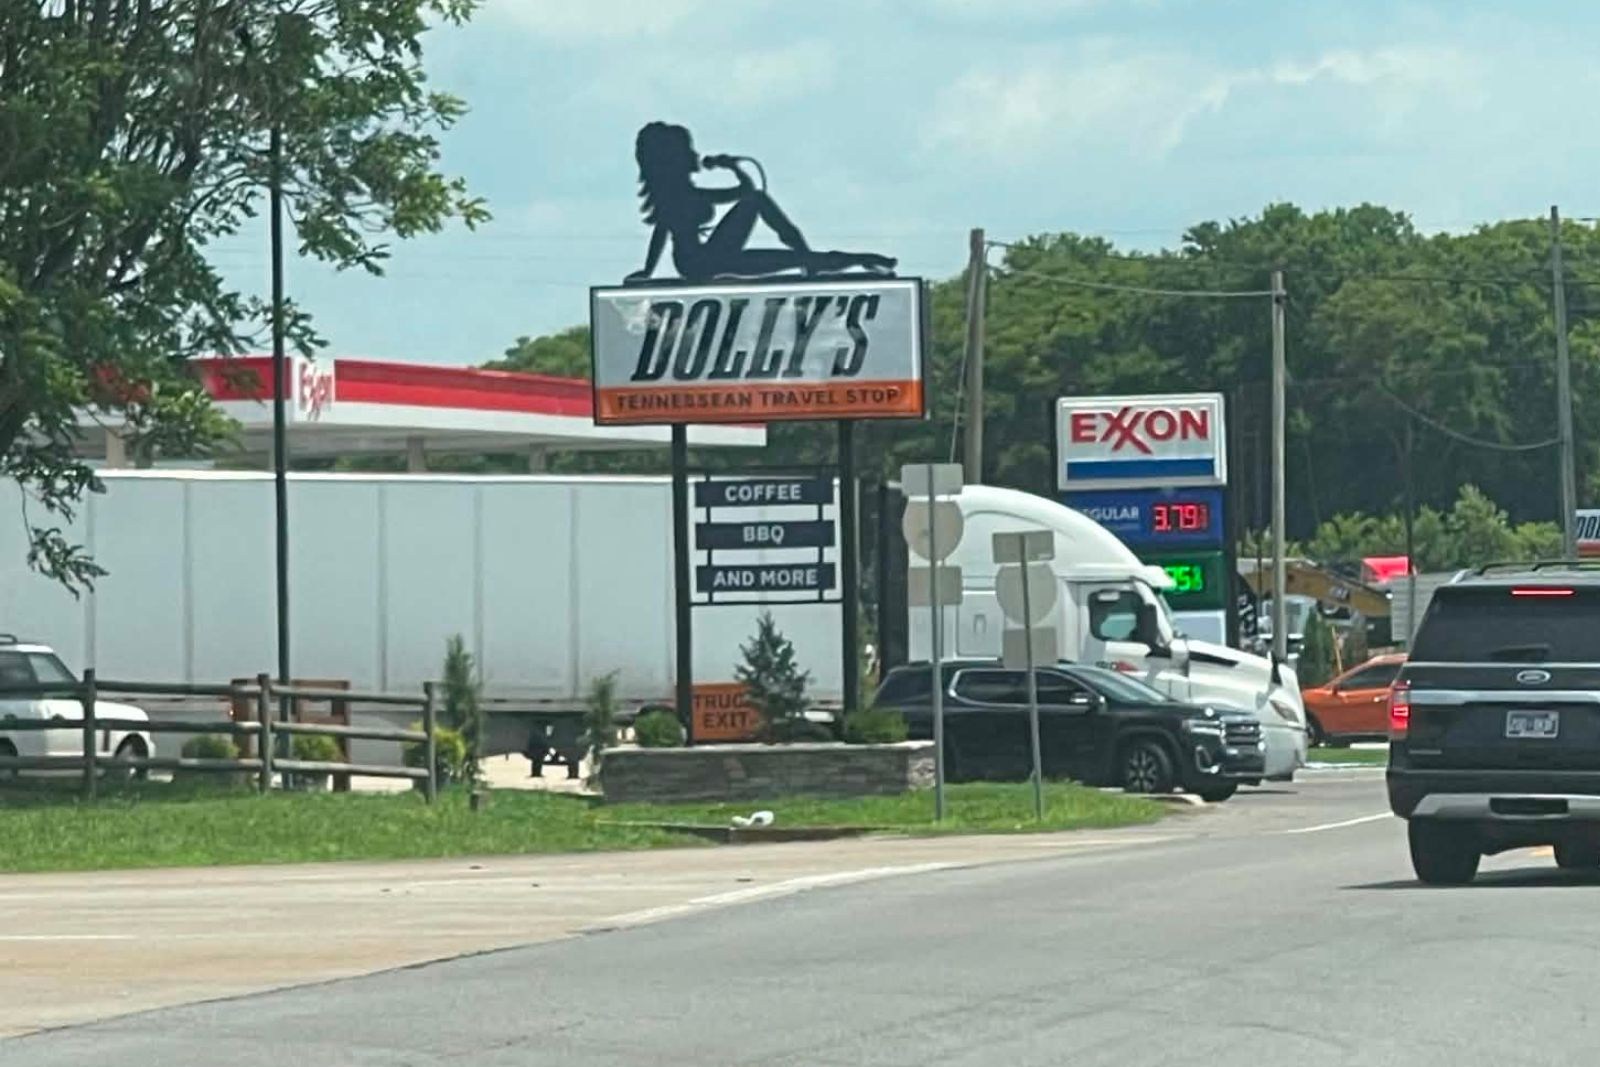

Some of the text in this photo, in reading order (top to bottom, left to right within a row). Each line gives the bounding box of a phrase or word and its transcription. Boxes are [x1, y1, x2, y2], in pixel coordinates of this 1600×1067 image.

[630, 294, 881, 381] DOLLY'S
[617, 387, 899, 411] TENNESSEAN TRAVEL STOP
[1071, 406, 1209, 455] EXXON
[725, 484, 802, 501] COFFEE
[743, 525, 785, 544] BBQ
[713, 569, 818, 588] AND MORE
[694, 693, 748, 709] TRUC
[704, 711, 748, 729] EXIT
